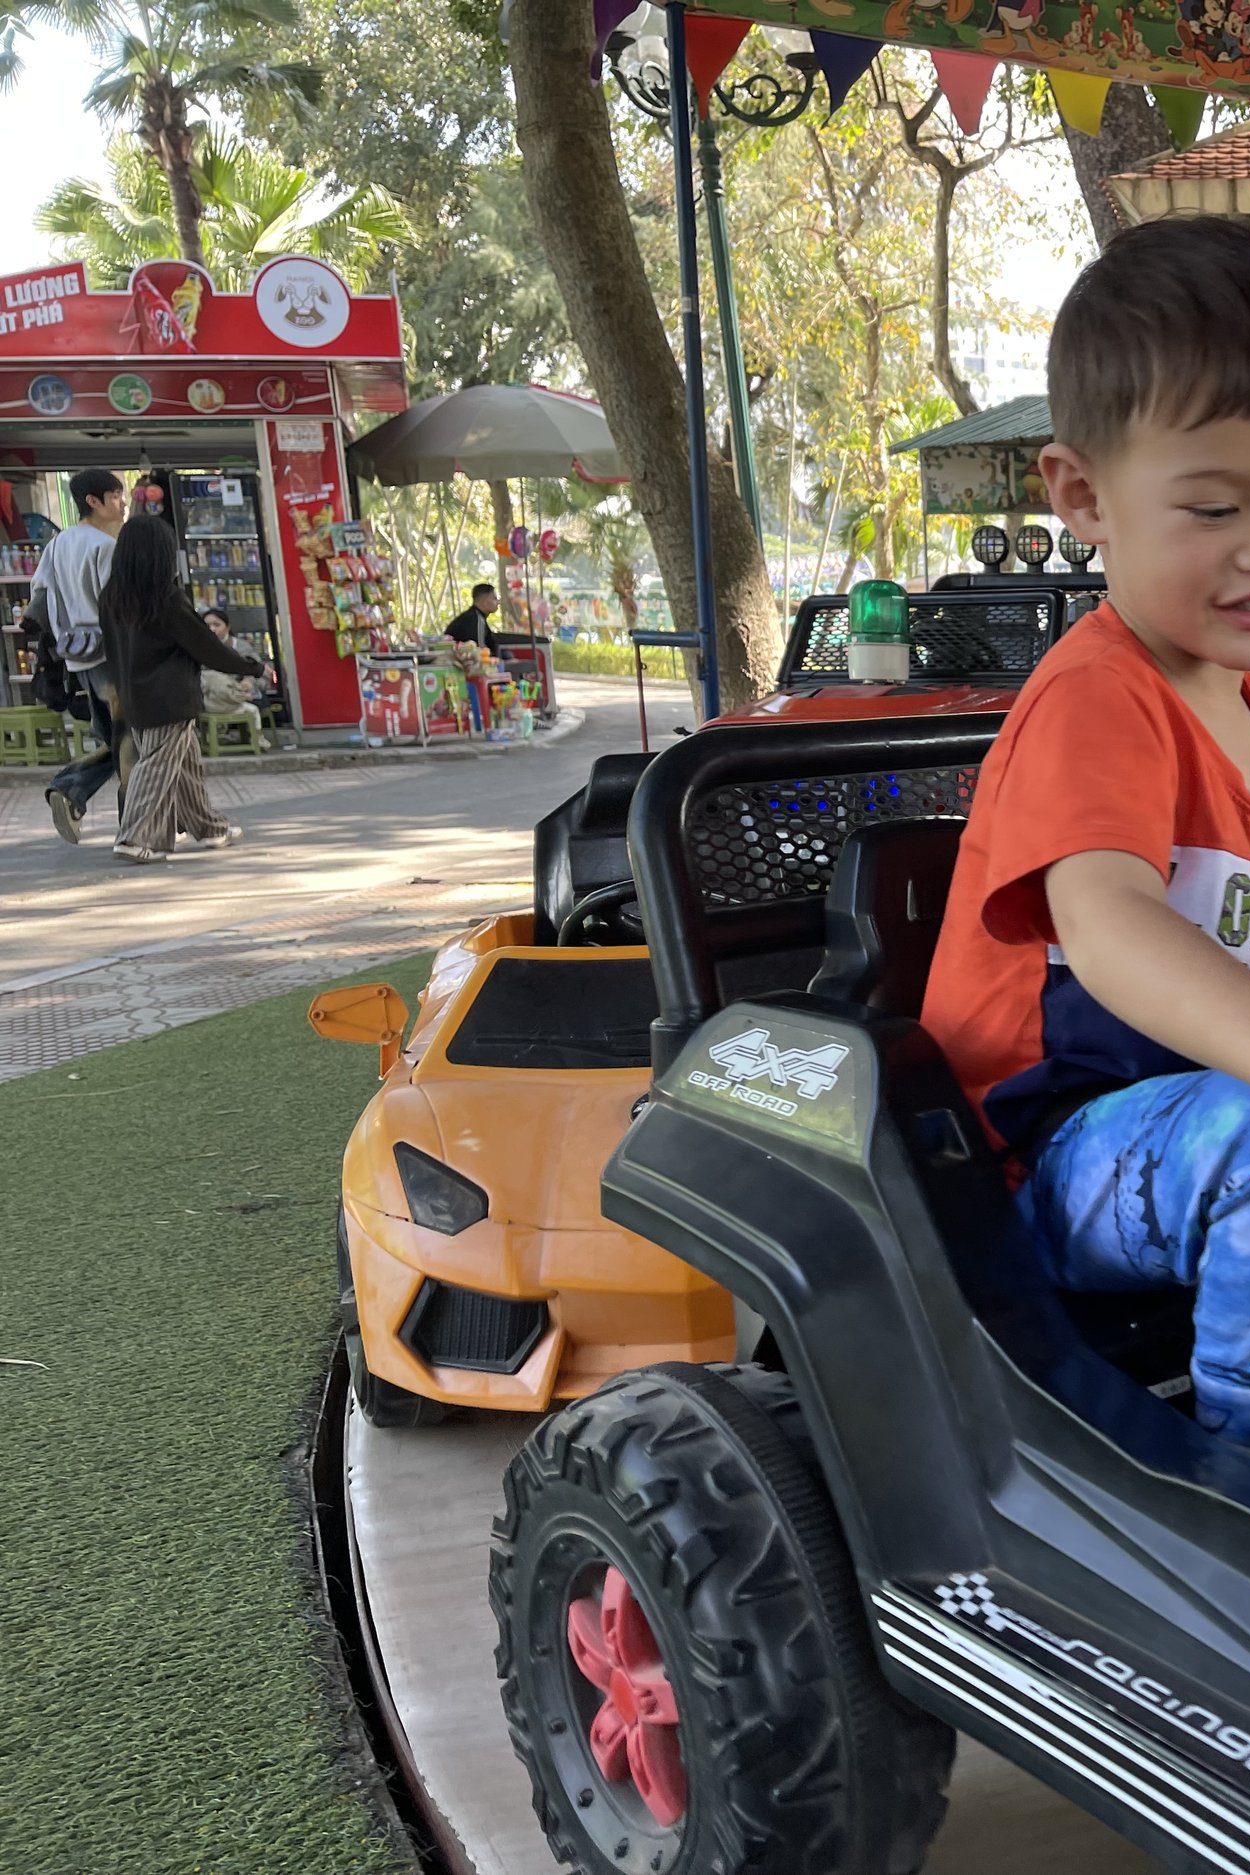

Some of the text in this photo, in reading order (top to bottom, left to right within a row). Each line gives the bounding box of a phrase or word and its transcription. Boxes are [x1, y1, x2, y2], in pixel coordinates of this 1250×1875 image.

[22, 300, 63, 329] PHÁ
[688, 1070, 799, 1117] OFF ROAD
